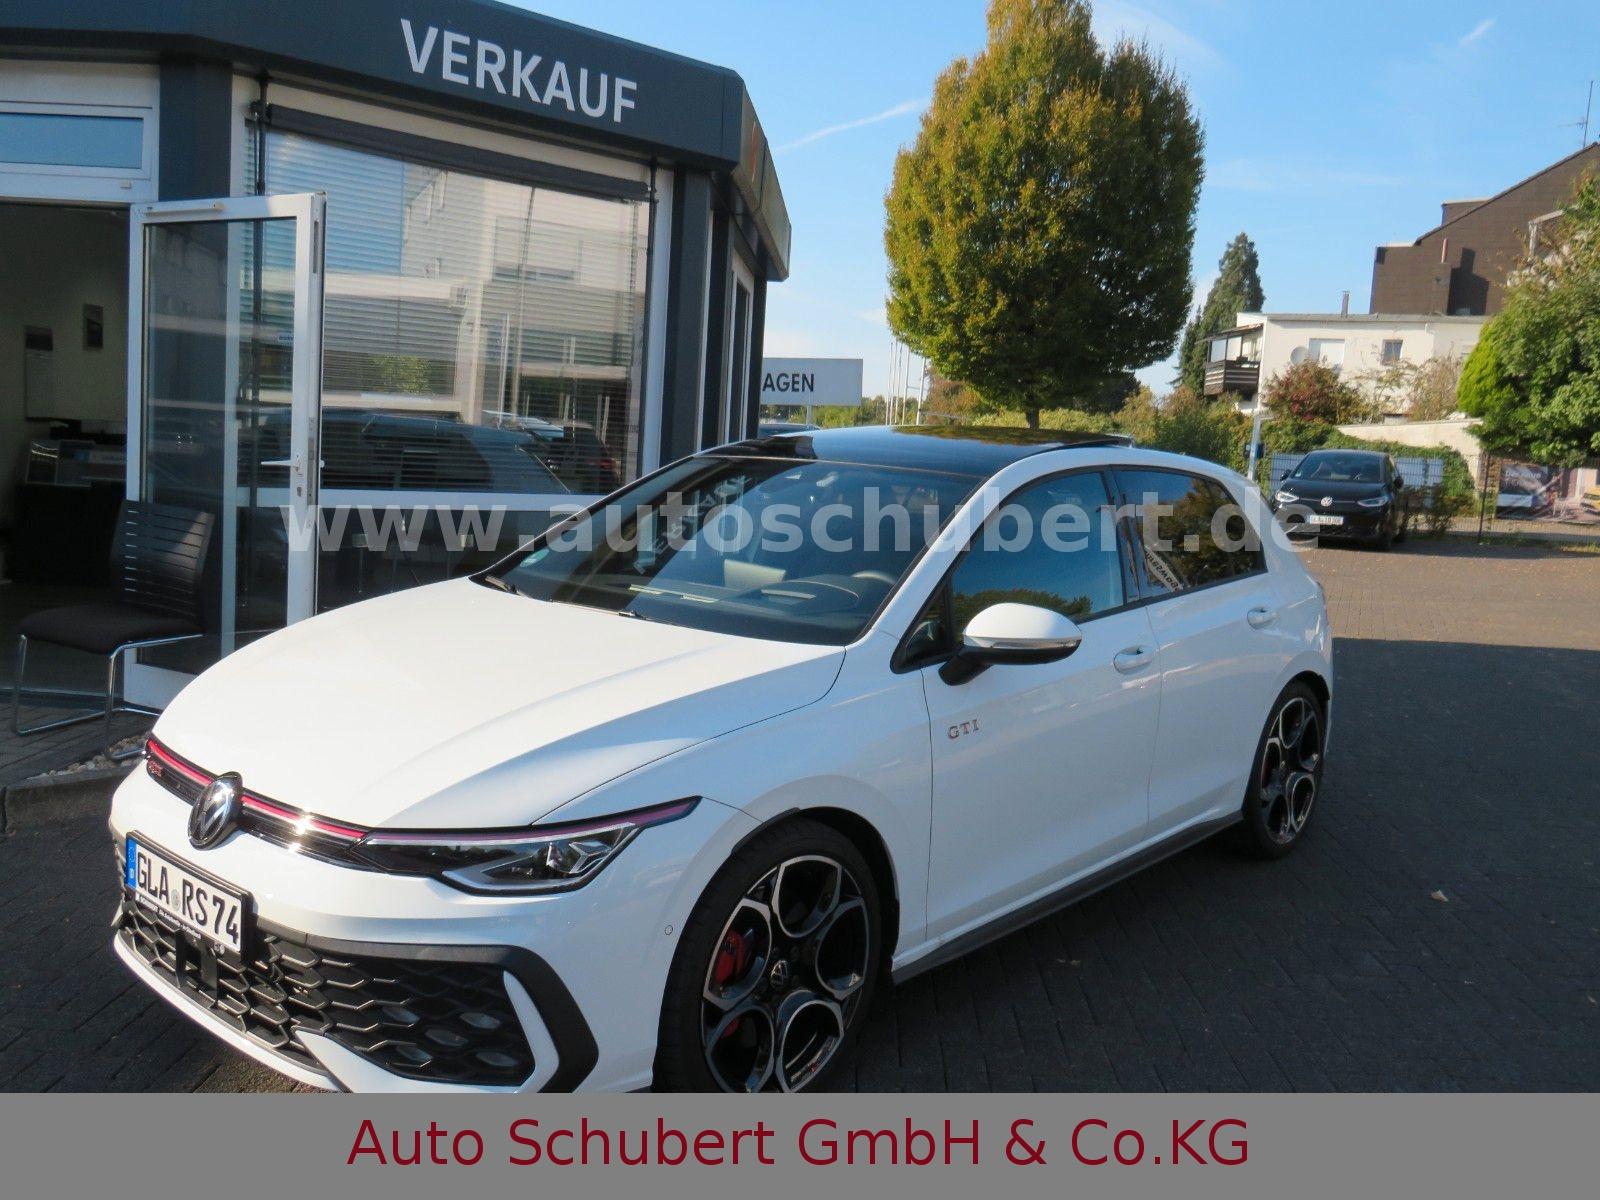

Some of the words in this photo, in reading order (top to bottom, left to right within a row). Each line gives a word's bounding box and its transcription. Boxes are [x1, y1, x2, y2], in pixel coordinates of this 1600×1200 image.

[400, 18, 638, 123] VERKAUF
[947, 719, 980, 739] GTI
[137, 851, 170, 905] GLA
[182, 878, 208, 926] RS
[212, 894, 240, 945] 74
